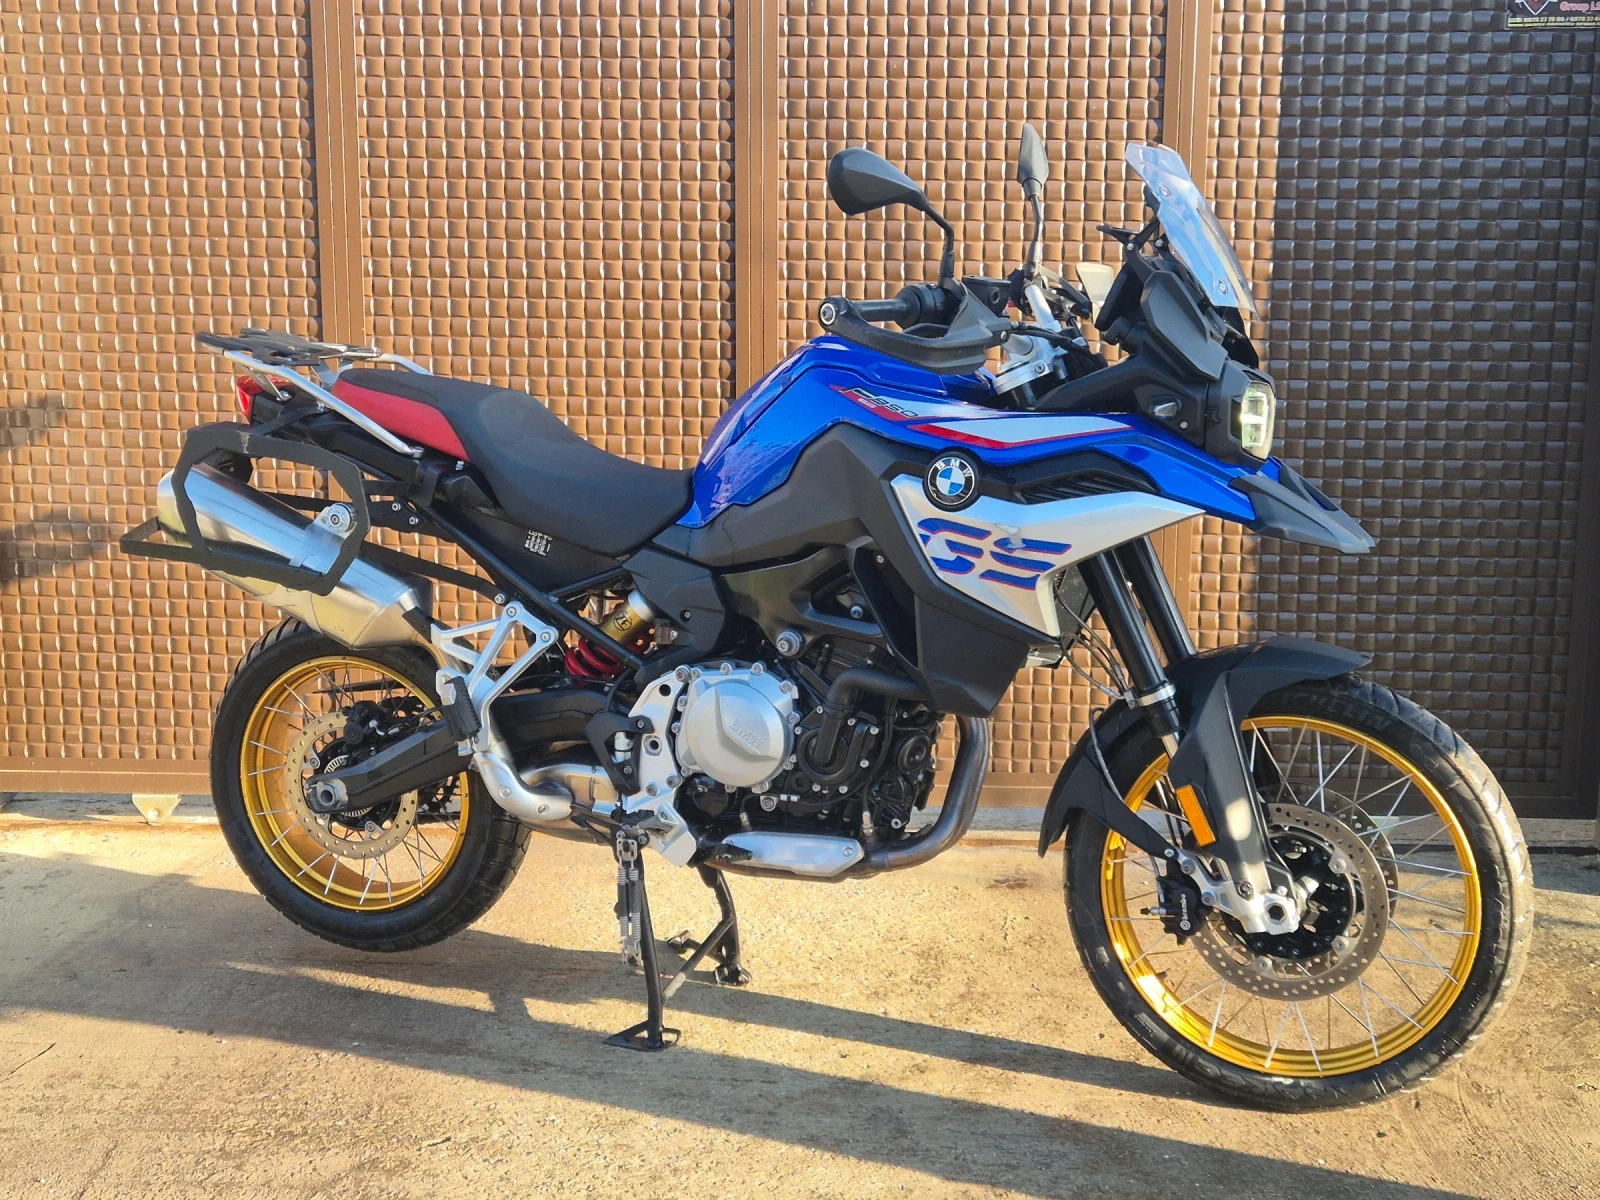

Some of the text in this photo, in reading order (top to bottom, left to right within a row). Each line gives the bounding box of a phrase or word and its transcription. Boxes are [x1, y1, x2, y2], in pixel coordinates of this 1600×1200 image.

[839, 387, 919, 418] F850
[935, 457, 974, 479] BMW
[917, 517, 1072, 591] GS
[729, 718, 766, 748] BMW
[1180, 893, 1189, 920] brembo
